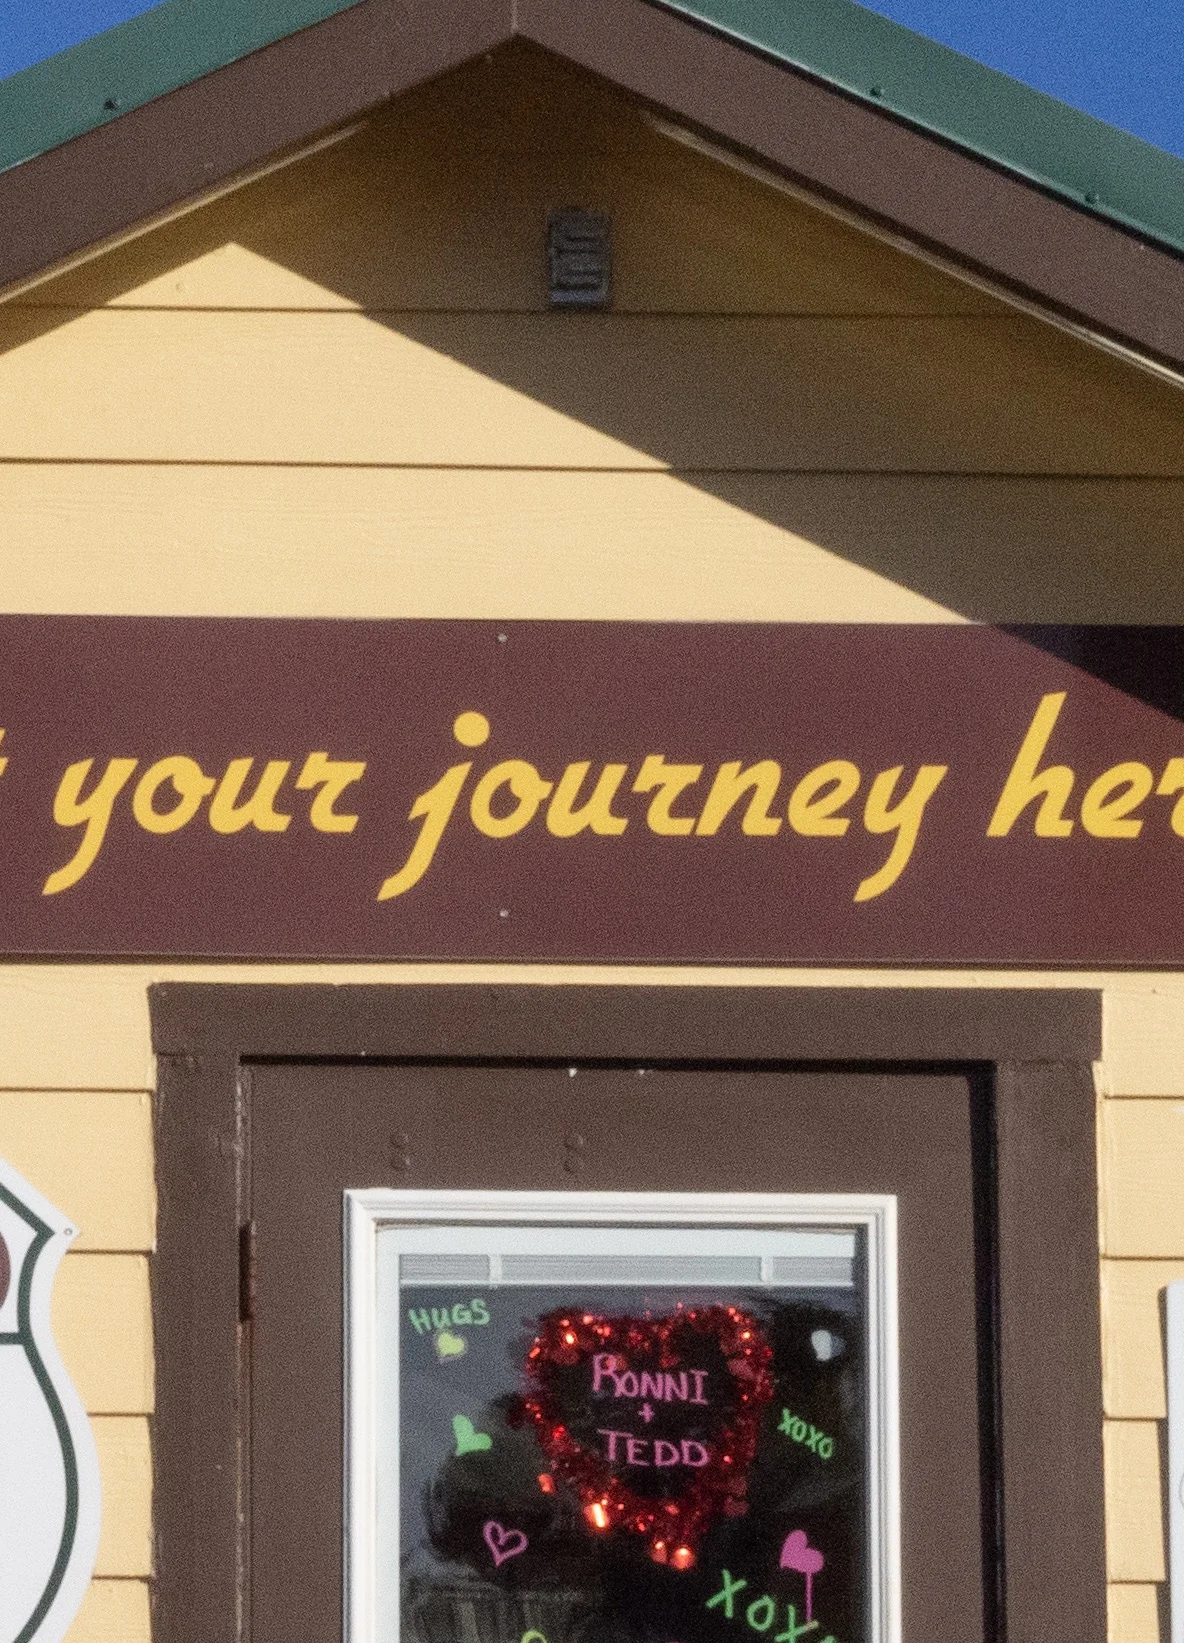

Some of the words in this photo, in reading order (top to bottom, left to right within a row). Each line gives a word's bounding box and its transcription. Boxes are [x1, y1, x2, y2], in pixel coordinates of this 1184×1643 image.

[42, 751, 367, 896] your
[377, 711, 950, 903] journey
[409, 1298, 492, 1334] HUGS
[592, 1351, 710, 1406] RONNI
[596, 1429, 711, 1468] TEDD
[777, 1406, 836, 1460] XOXO
